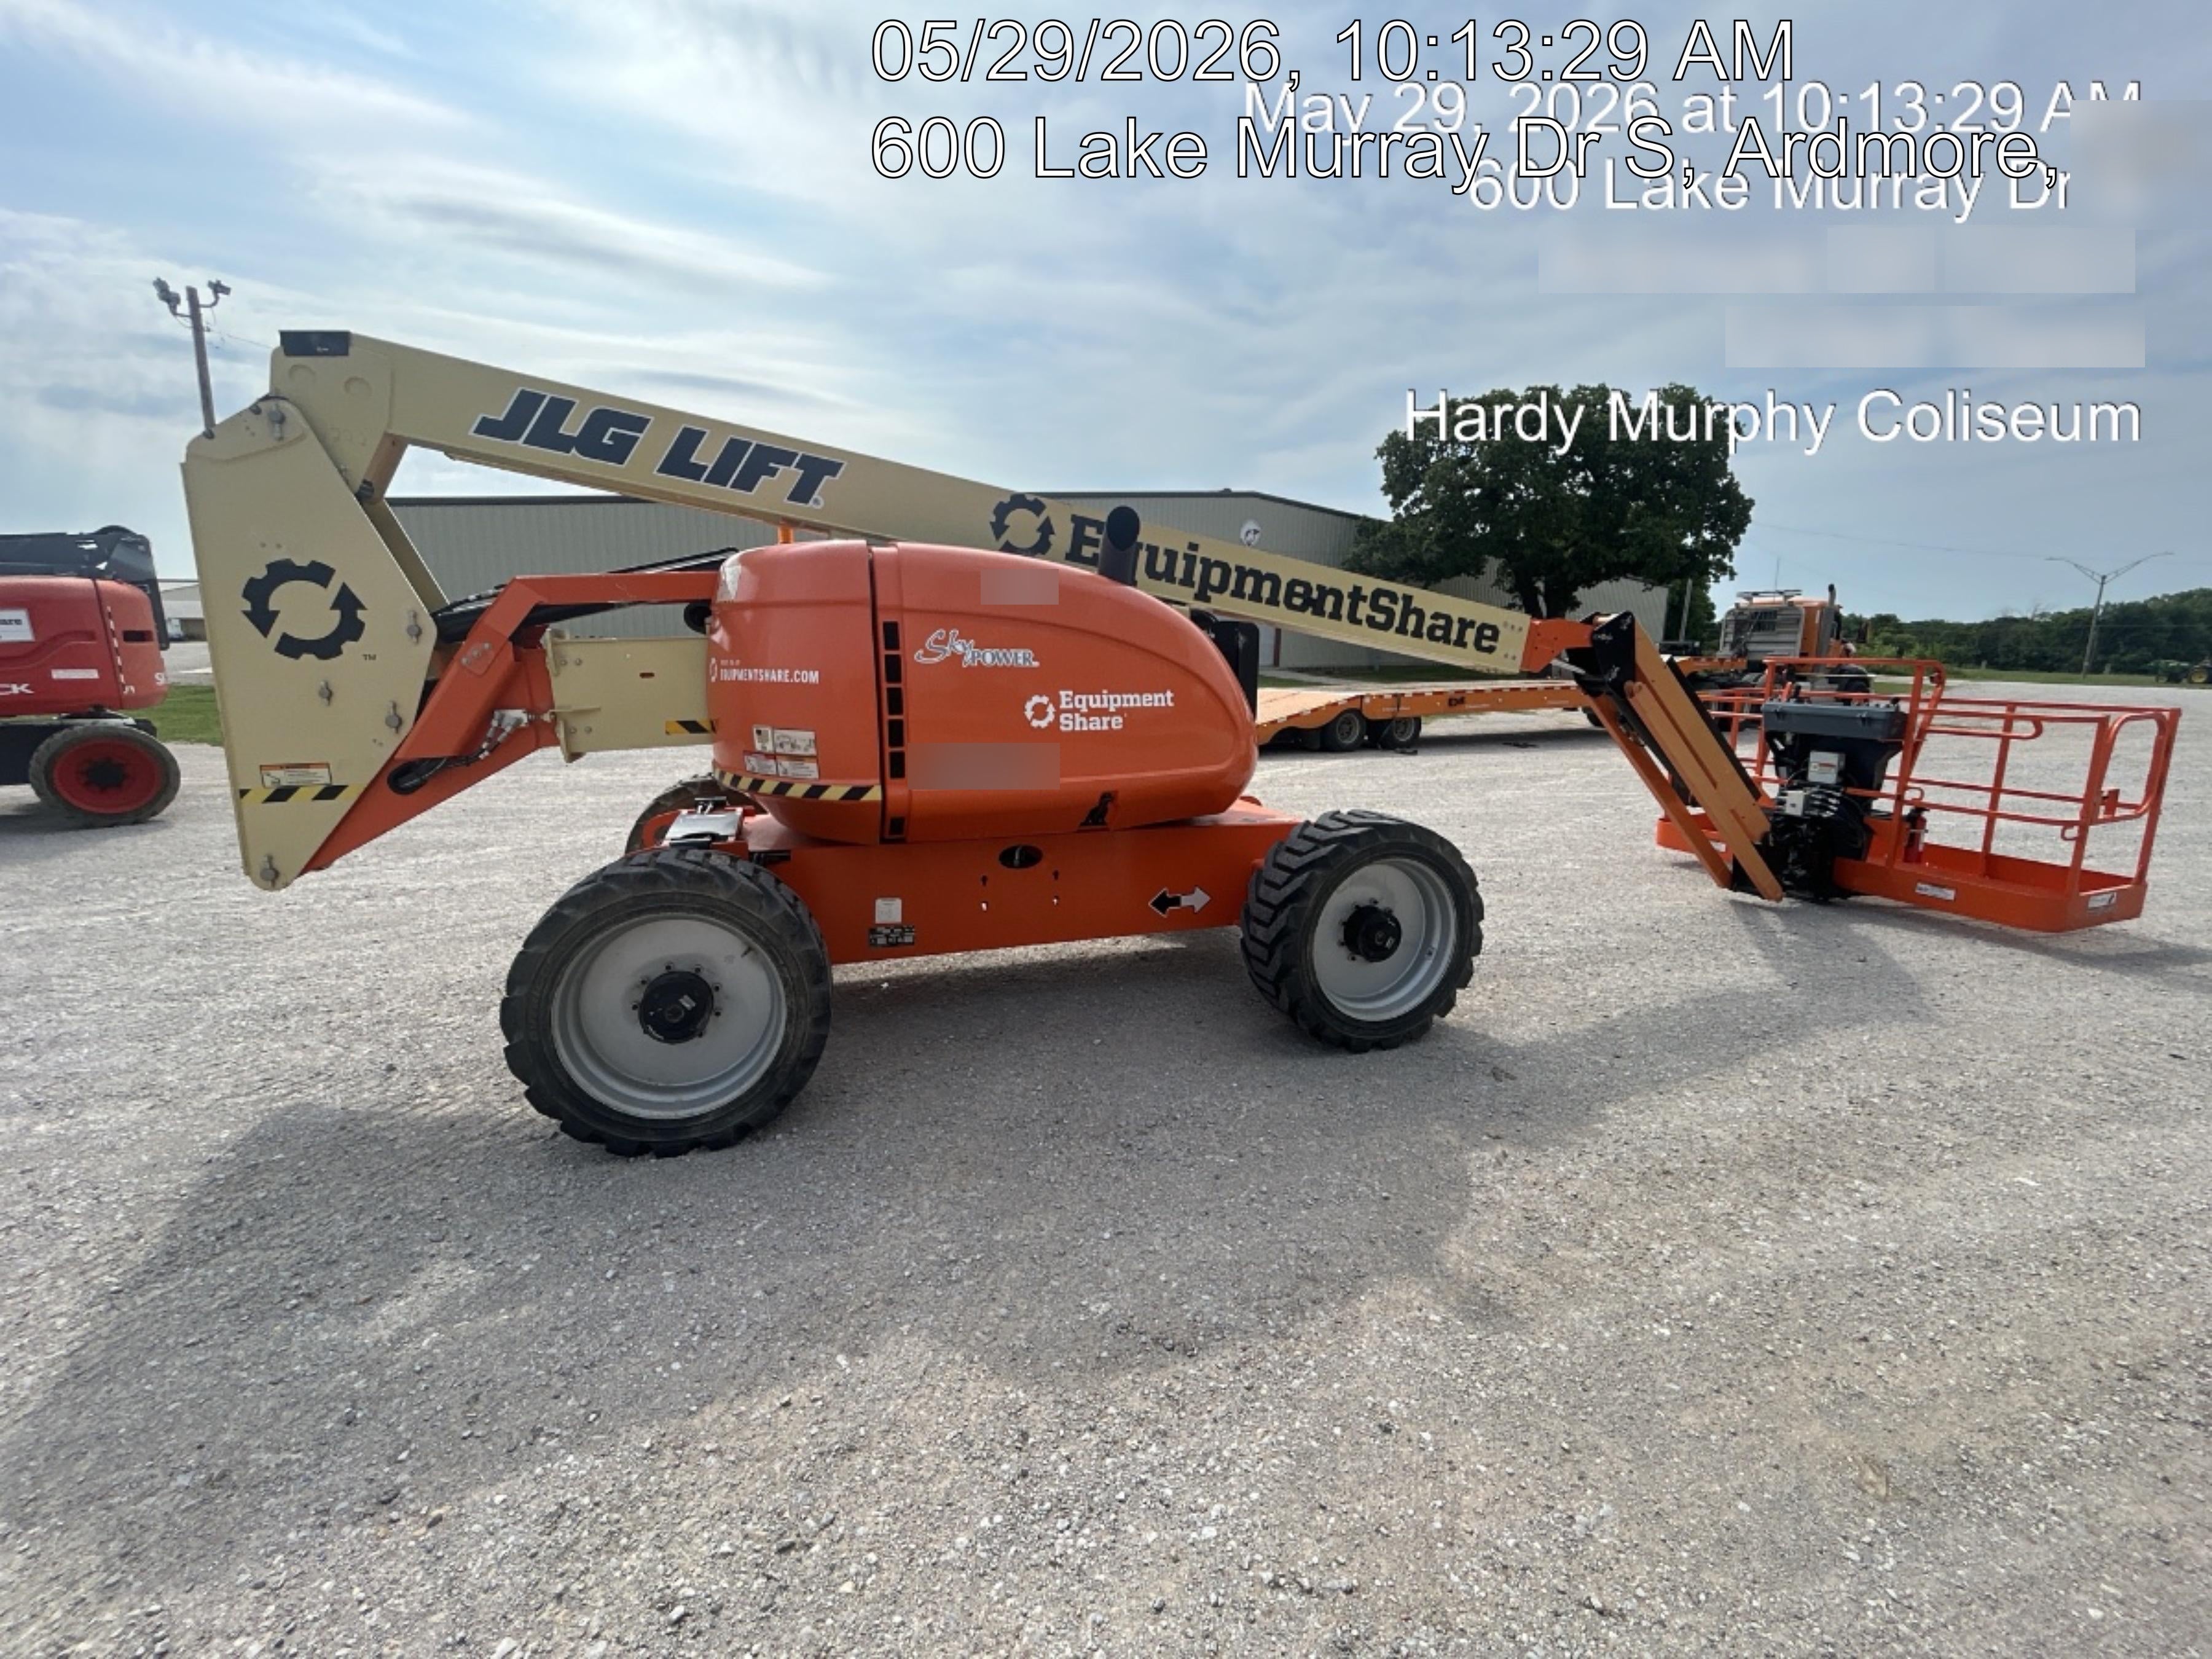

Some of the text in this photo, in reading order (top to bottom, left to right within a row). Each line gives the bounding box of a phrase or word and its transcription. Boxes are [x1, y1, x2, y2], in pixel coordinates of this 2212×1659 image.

[468, 387, 847, 507] JLG LIFT
[1065, 513, 1499, 656] EuipmentShare
[1059, 689, 1175, 712] Equipment
[1059, 713, 1124, 732] Share
